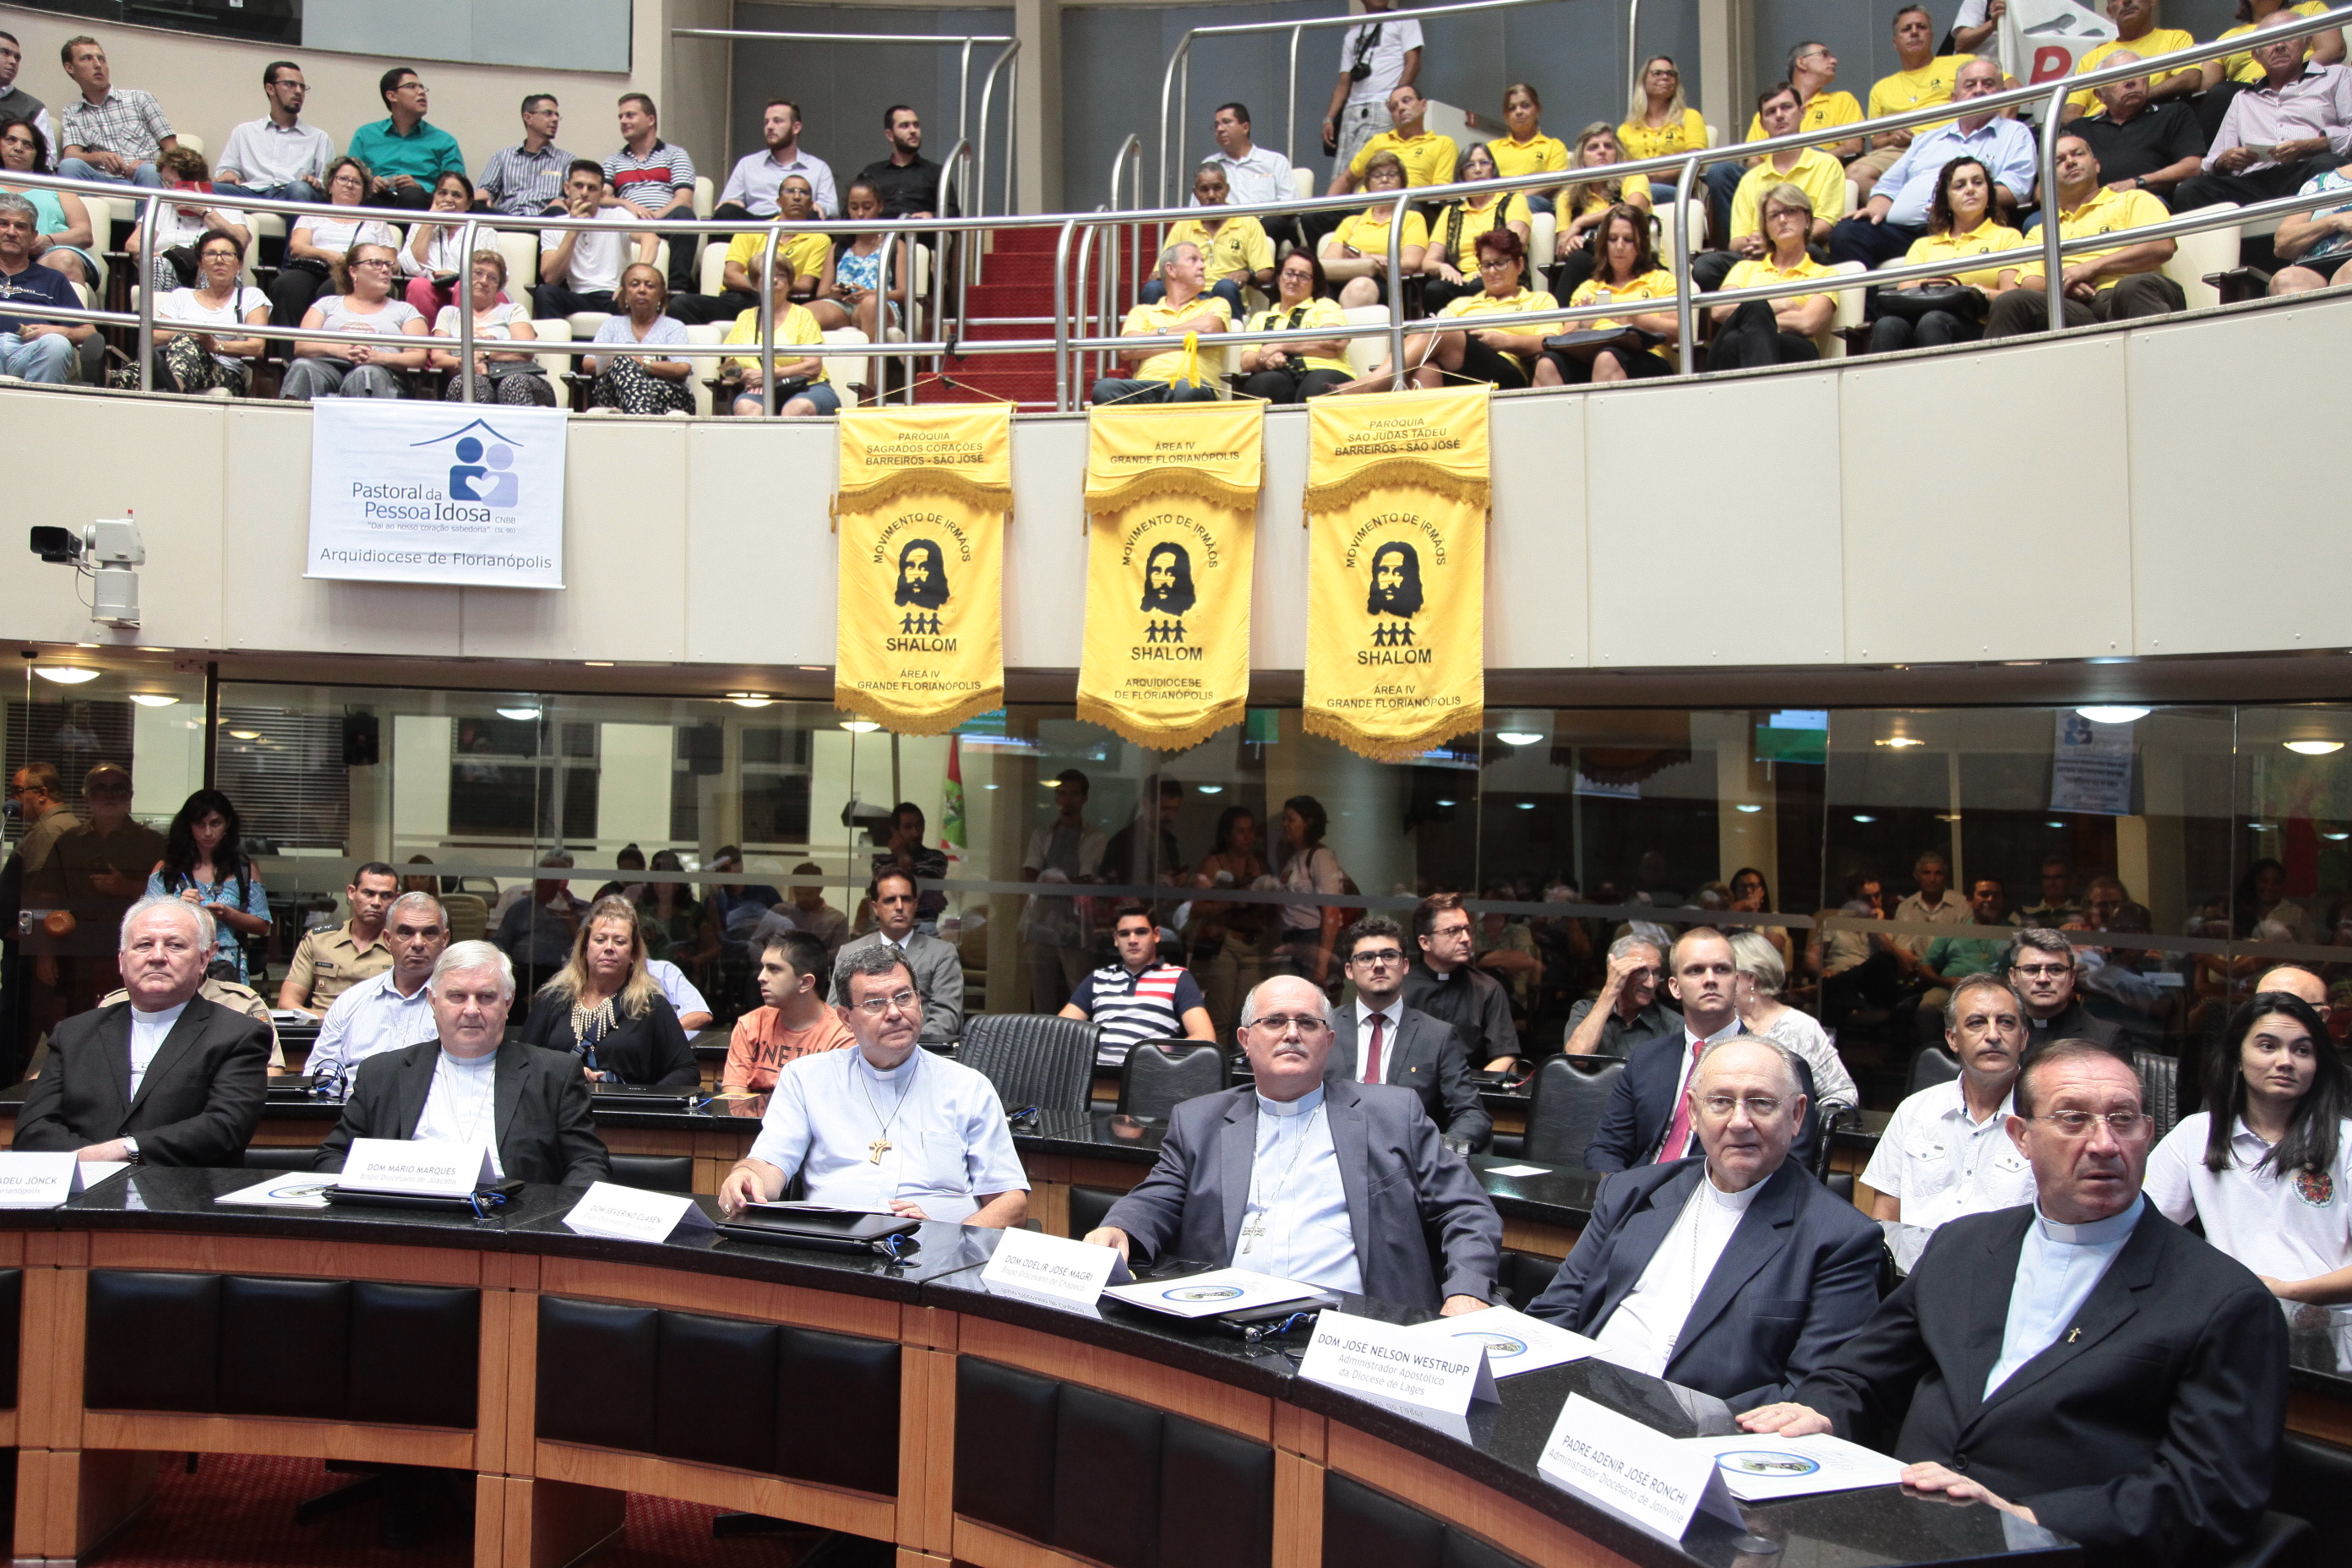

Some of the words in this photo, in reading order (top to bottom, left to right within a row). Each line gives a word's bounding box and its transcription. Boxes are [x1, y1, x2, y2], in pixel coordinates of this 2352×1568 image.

[1369, 418, 1424, 428] PARÓQUIA
[899, 432, 950, 441] PARÓQUIA
[1373, 431, 1408, 441] JUDAS
[1412, 428, 1446, 438] TADEU
[867, 445, 923, 454] SAGRADOS
[927, 443, 983, 453] CORAÇÕES
[1155, 441, 1182, 450] ÁREA
[1335, 444, 1396, 455] BARREIROS
[1431, 438, 1461, 450] JOSÉ
[866, 456, 924, 466] BARREIROS
[957, 454, 984, 464] JOSÉ
[1110, 455, 1152, 464] GRANDE
[1156, 451, 1239, 463] FLORIANÓPOLIS
[353, 482, 422, 499] Pastoral
[426, 488, 442, 500] da
[365, 502, 430, 520] Pessoa
[434, 504, 490, 522] Idosa
[421, 524, 449, 533] coração
[874, 513, 923, 564] MOVIMENTO
[928, 513, 944, 525] DE
[945, 519, 971, 562] IRMÃOS
[1123, 514, 1173, 565] MOVIMENTO
[1176, 515, 1193, 528] DE
[1194, 524, 1217, 568] IRMÃOS
[1347, 513, 1398, 568] MOVIMENTO
[1402, 514, 1419, 525] DE
[1420, 520, 1446, 565] IRMÃOS
[320, 548, 422, 564] Arquidiocese
[428, 552, 446, 564] de
[454, 553, 552, 569] Florianópolis
[887, 638, 956, 651] SHALOM
[1131, 647, 1202, 661] SHALOM
[1358, 649, 1431, 665] SHALOM
[901, 669, 928, 678] ÁREA
[858, 682, 898, 690] GRANDE
[902, 682, 981, 690] FLORIANÓPOLIS
[1125, 678, 1201, 687] ARQUIDIOCESE
[1375, 684, 1402, 694] ÁREA
[1406, 685, 1416, 694] IV
[1132, 690, 1213, 700] FLORIANÓPOLIS
[1327, 699, 1372, 708] GRANDE
[1375, 696, 1461, 708] FLORIANÓPOLIS
[388, 1164, 414, 1173] MÁRIO
[416, 1167, 456, 1175] MARQUES
[24, 1175, 58, 1184] JÖNCK
[606, 1208, 636, 1218] SEVERINO
[637, 1213, 662, 1223] CLASEN
[1001, 1266, 1017, 1276] Bispo
[1018, 1270, 1048, 1283] Diocesano
[1005, 1255, 1021, 1266] DOM
[1023, 1260, 1048, 1271] ODELIR
[1049, 1266, 1069, 1276] JOSÉ
[1069, 1270, 1093, 1281] MAGRI
[1318, 1333, 1340, 1348] DOM
[1342, 1340, 1366, 1353] JOSÉ
[1370, 1346, 1410, 1363] NELSON
[1413, 1354, 1469, 1376] WESTRUPP
[1338, 1354, 1397, 1375] Administrador
[1399, 1368, 1445, 1386] Apostólico
[1339, 1368, 1349, 1377] da
[1352, 1369, 1385, 1386] Diocese
[1386, 1377, 1397, 1388] de
[1400, 1381, 1425, 1396] Lages
[1562, 1435, 1591, 1458] PADRE
[1591, 1450, 1625, 1475] ADENIR
[1625, 1467, 1649, 1487] JOSÉ
[1650, 1478, 1688, 1505] RONCHI
[1549, 1448, 1598, 1480] Administrador
[1598, 1472, 1636, 1500] Diocesano
[1638, 1494, 1648, 1506] de
[1649, 1500, 1684, 1523] Joinville
